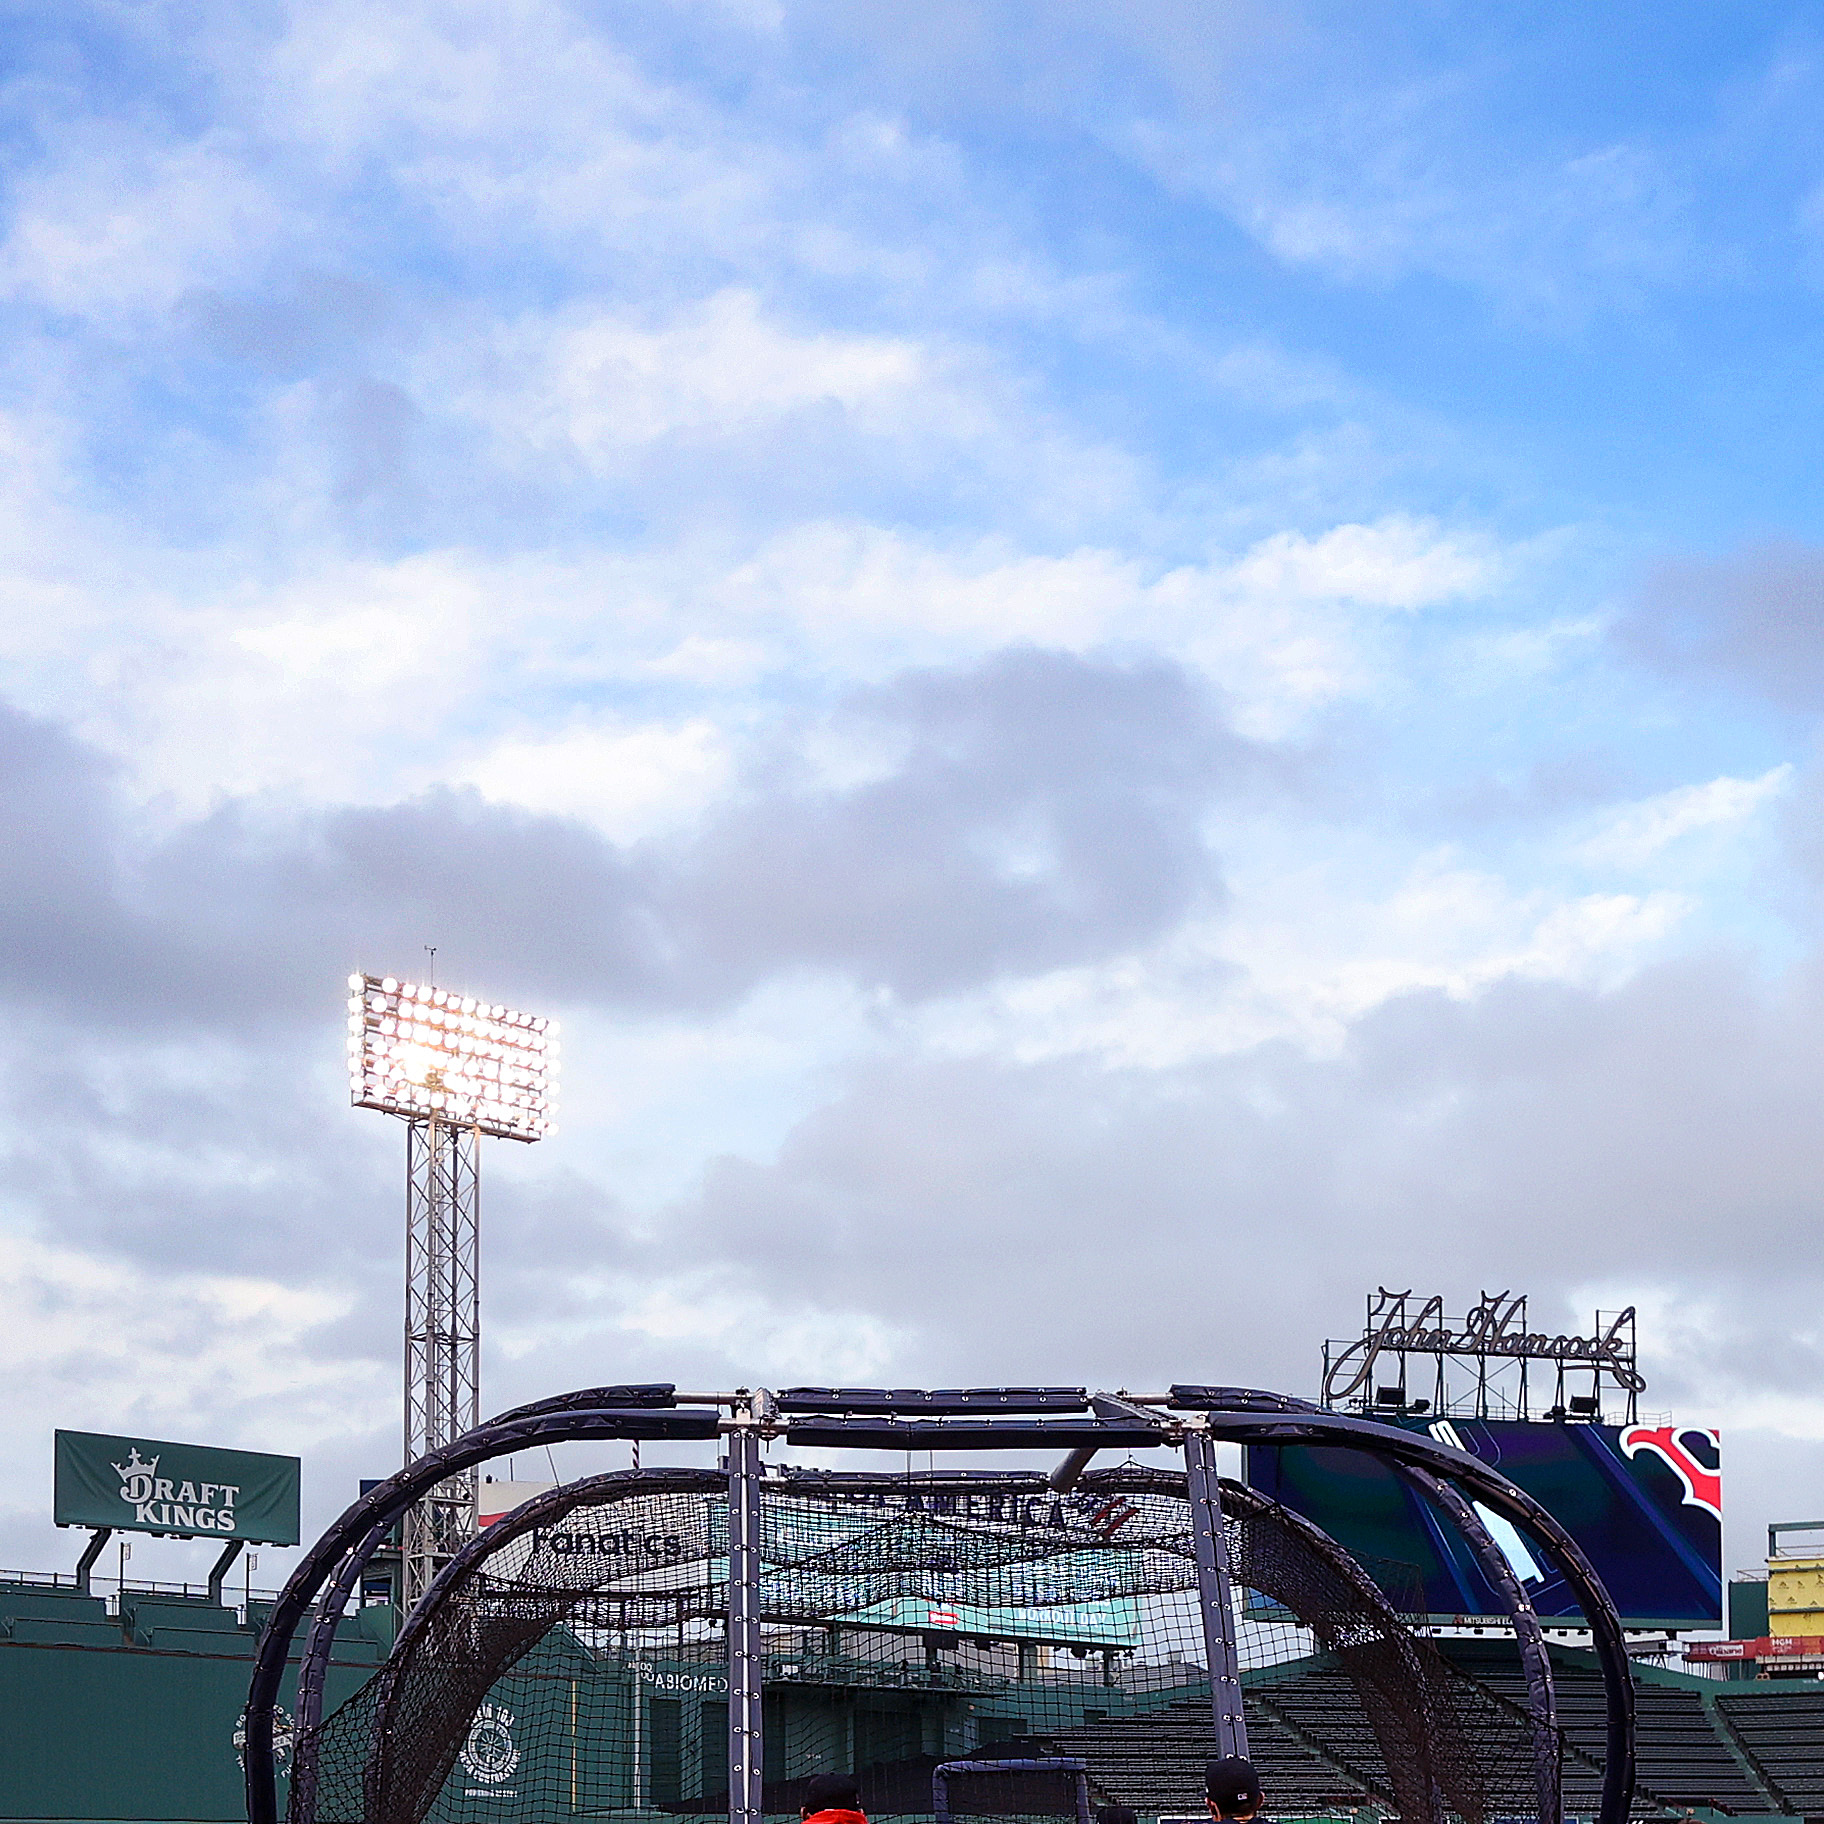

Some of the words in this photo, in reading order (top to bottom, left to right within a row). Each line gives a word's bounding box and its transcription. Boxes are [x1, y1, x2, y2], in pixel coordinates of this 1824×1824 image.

[1326, 1286, 1452, 1399] John
[1450, 1289, 1646, 1392] Hancock
[120, 1475, 240, 1507] DRAFT
[135, 1500, 235, 1531] KINGS
